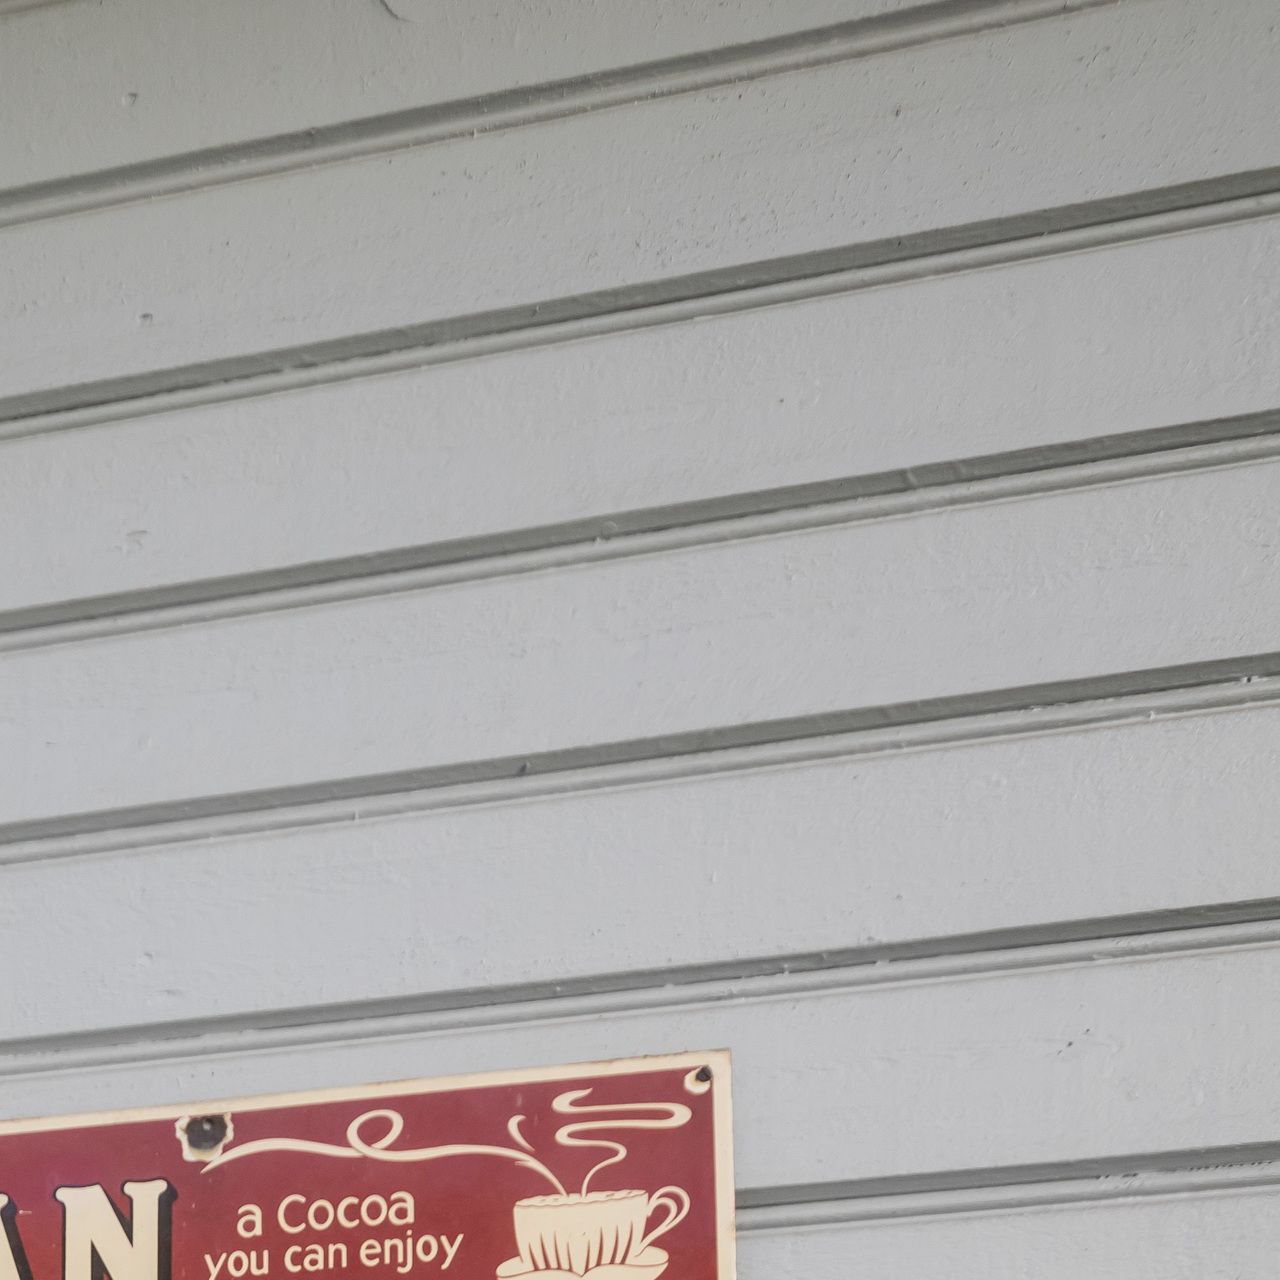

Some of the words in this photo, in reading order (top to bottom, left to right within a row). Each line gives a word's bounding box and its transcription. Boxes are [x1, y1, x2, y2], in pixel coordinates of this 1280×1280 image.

[237, 1202, 263, 1240] a
[276, 1192, 416, 1235] Cocoa
[283, 1240, 349, 1272] can
[359, 1230, 465, 1272] enjoy
